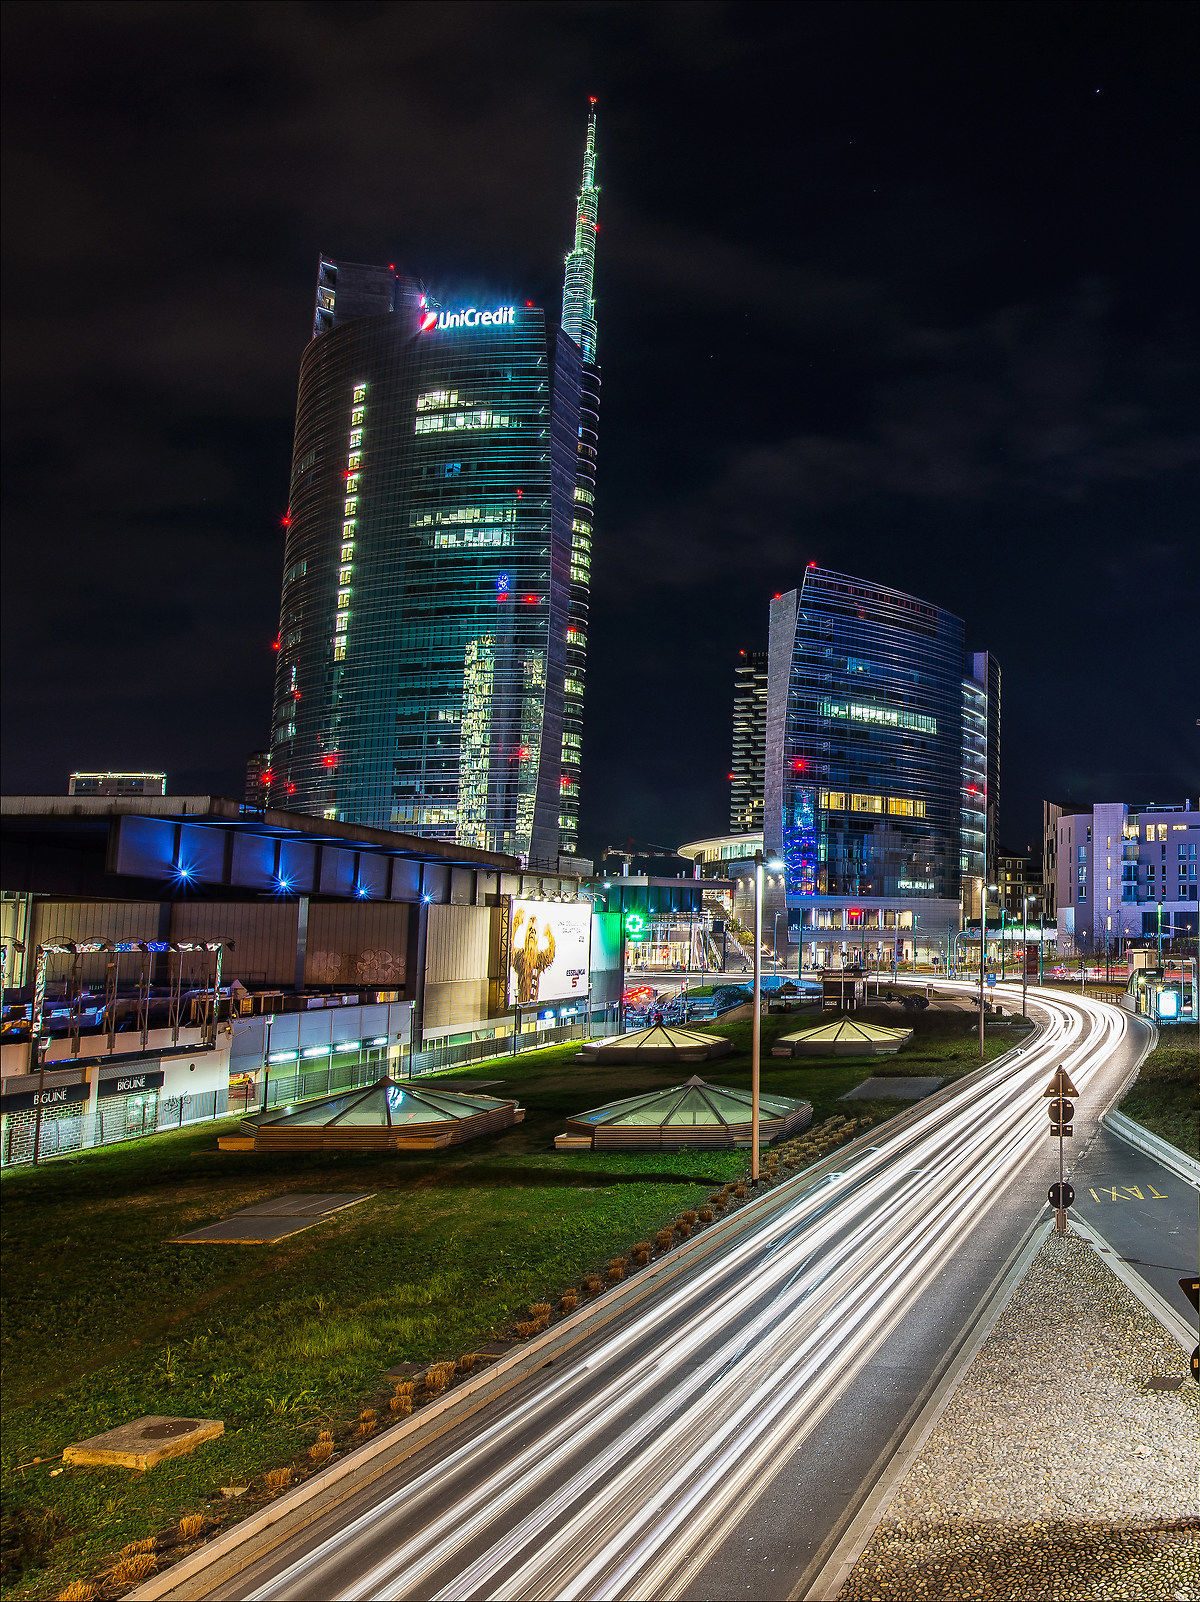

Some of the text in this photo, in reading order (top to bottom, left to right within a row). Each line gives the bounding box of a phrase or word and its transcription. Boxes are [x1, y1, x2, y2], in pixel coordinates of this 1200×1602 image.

[439, 306, 515, 329] UniCredit
[116, 1077, 146, 1092] BIGUINE
[33, 1089, 67, 1105] BGUINE
[1087, 1184, 1169, 1203] TAXI
